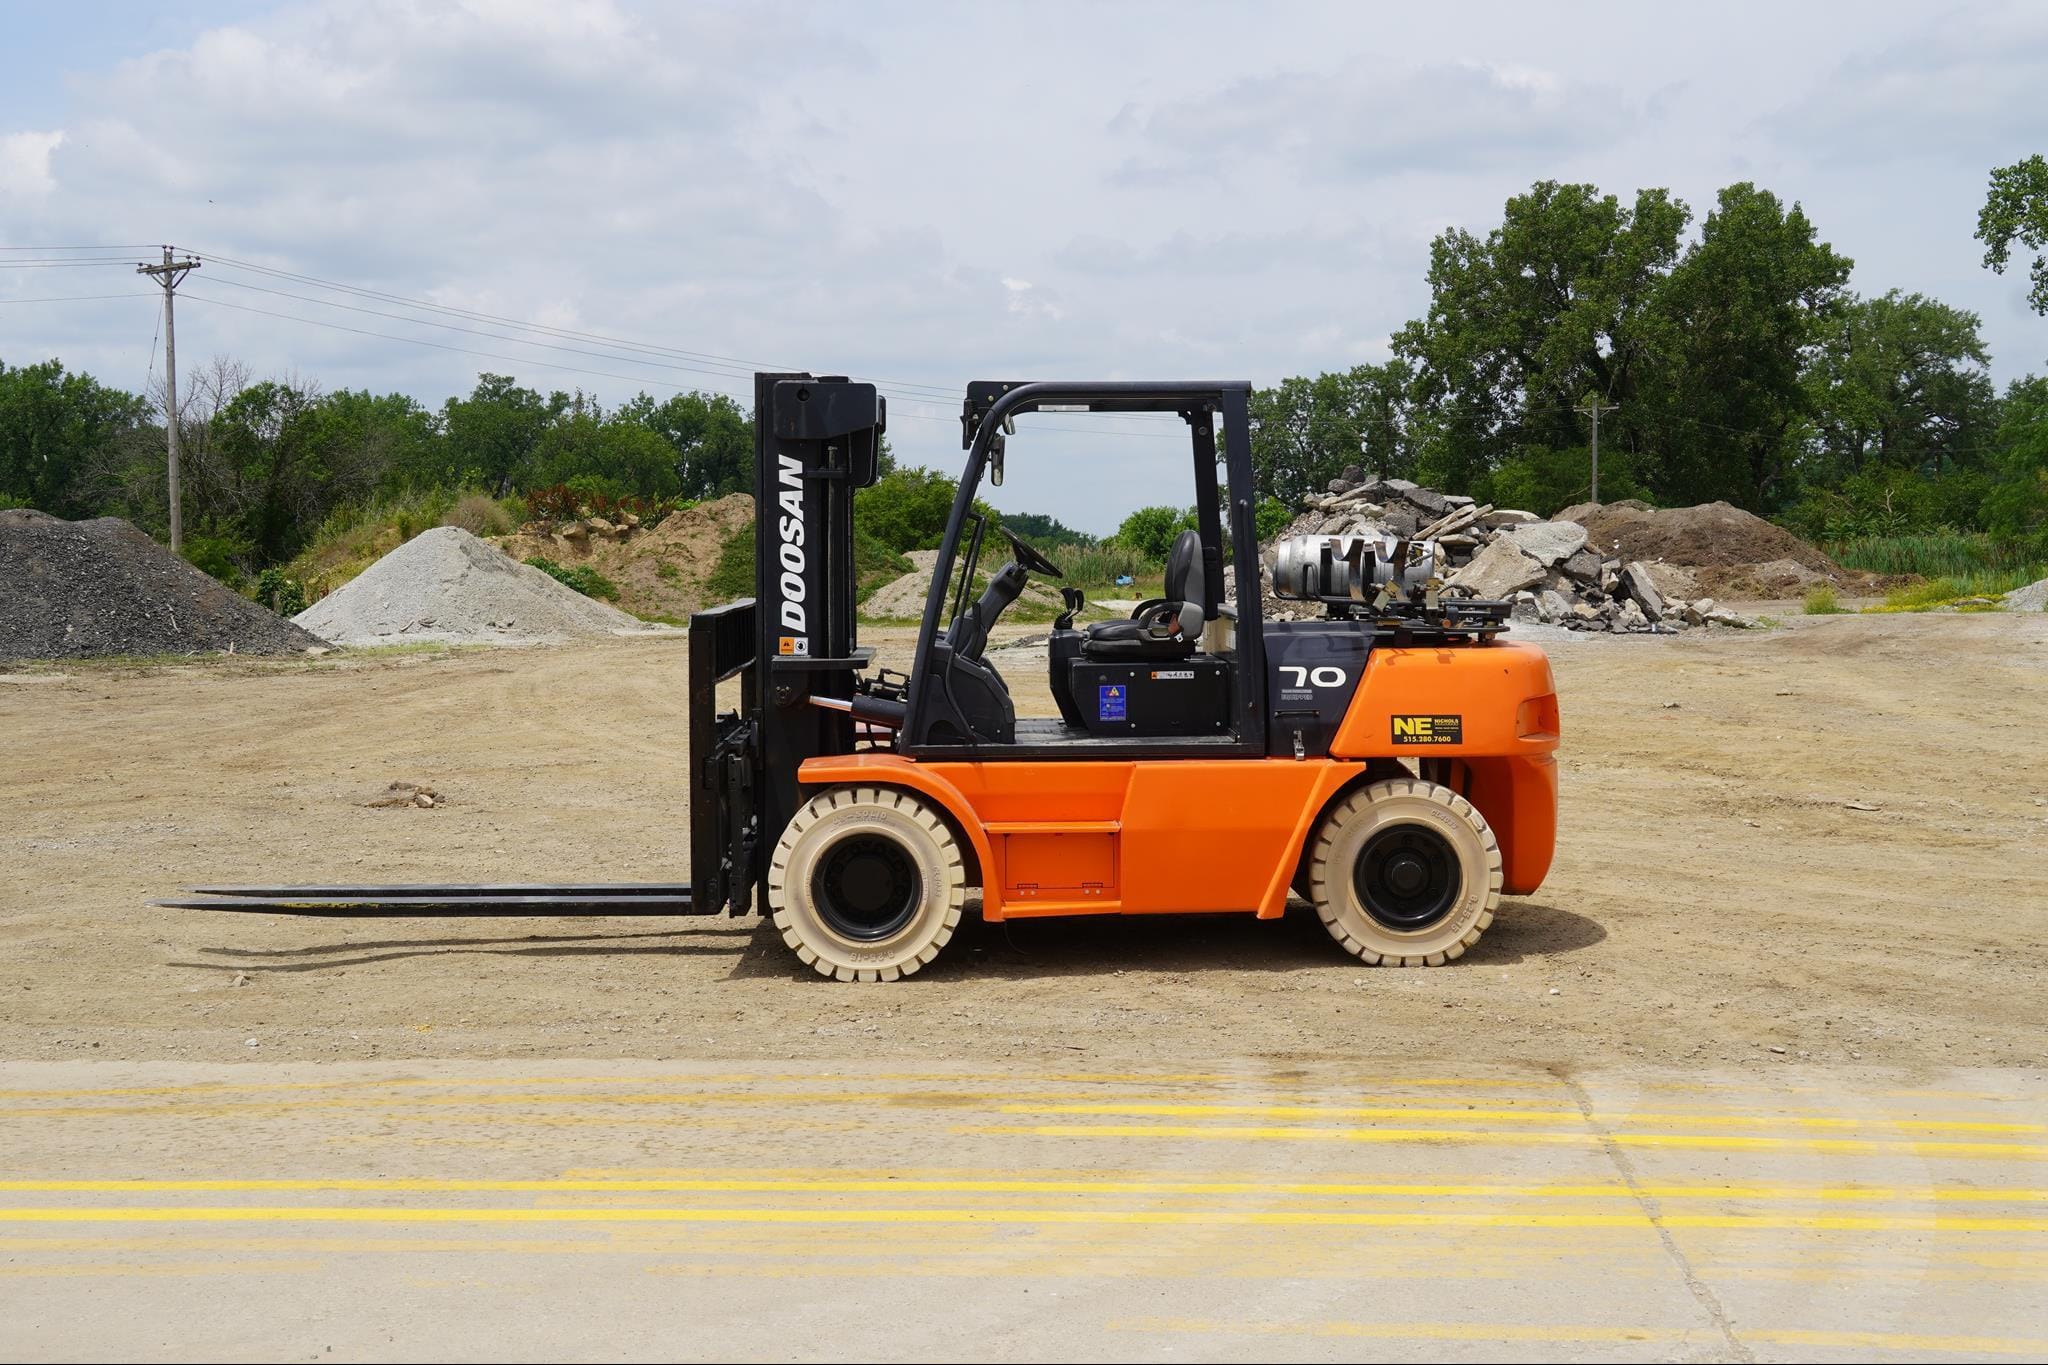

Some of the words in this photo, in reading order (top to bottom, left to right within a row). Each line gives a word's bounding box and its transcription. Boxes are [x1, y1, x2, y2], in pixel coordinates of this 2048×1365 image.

[779, 454, 805, 632] DOOSAN
[1279, 666, 1347, 688] 70
[1393, 717, 1433, 735] NE
[1403, 735, 1452, 743] 515.280.7600
